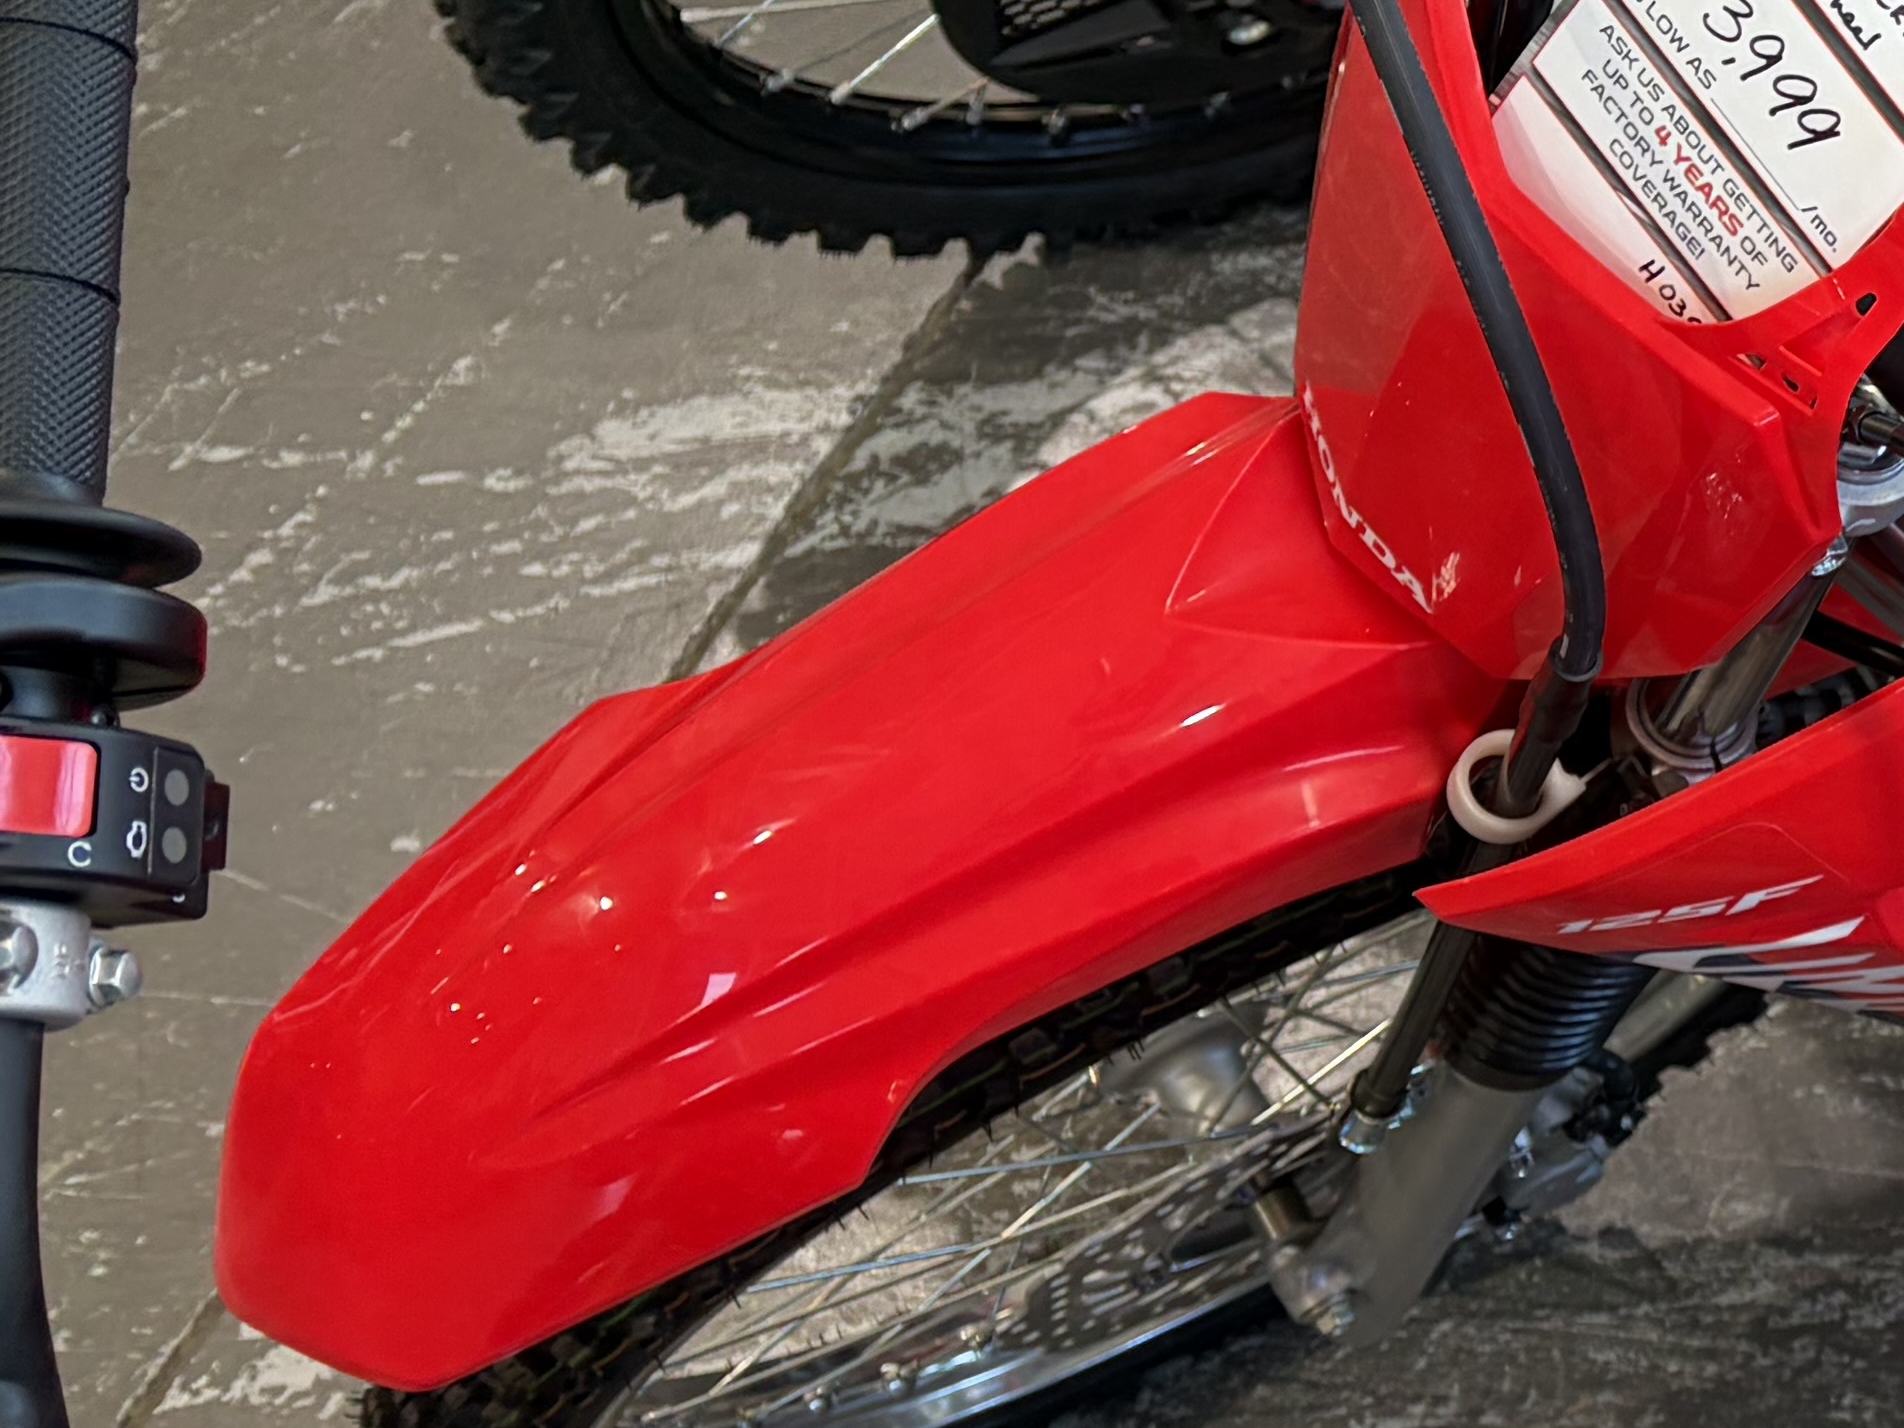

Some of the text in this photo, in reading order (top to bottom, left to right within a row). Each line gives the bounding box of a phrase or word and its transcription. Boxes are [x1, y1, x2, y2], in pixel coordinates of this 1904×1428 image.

[1580, 68, 1761, 291] FACTORY WARRANTY
[1598, 24, 1799, 274] ASK US ABOUT GETTING
[1602, 58, 1769, 267] UP TO 4 YEARS OF
[1608, 138, 1706, 261] COVERAGE!
[1644, 0, 1692, 55] LOW
[1685, 55, 1718, 91] AS
[1800, 205, 1839, 254] /mo.
[1556, 874, 1824, 935] 125F
